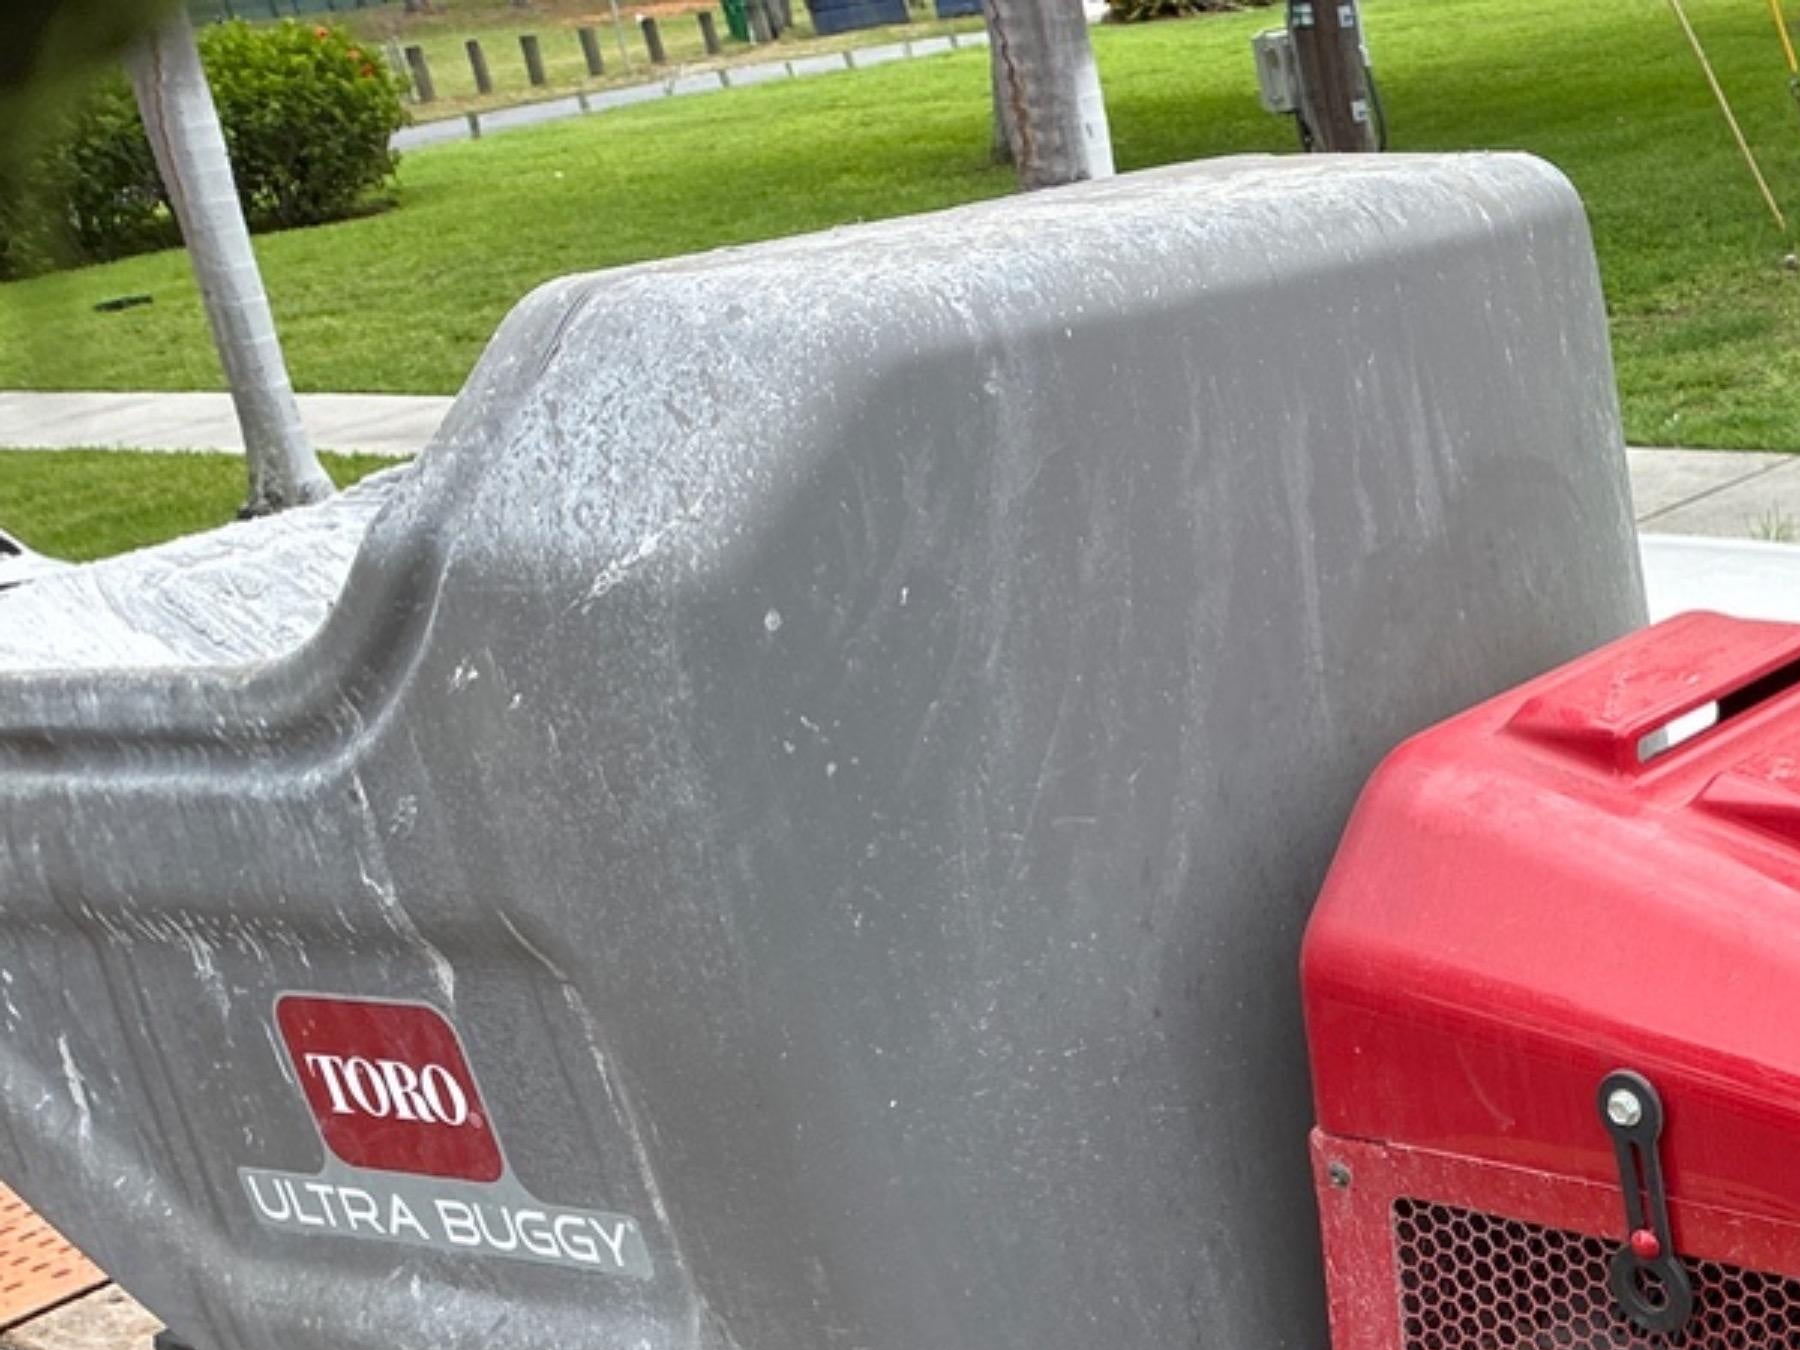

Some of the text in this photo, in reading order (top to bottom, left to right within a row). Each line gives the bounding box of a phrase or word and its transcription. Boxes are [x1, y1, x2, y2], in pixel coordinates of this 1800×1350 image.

[304, 1052, 469, 1127] TORO
[246, 1174, 625, 1267] ULTRA BUGGY
